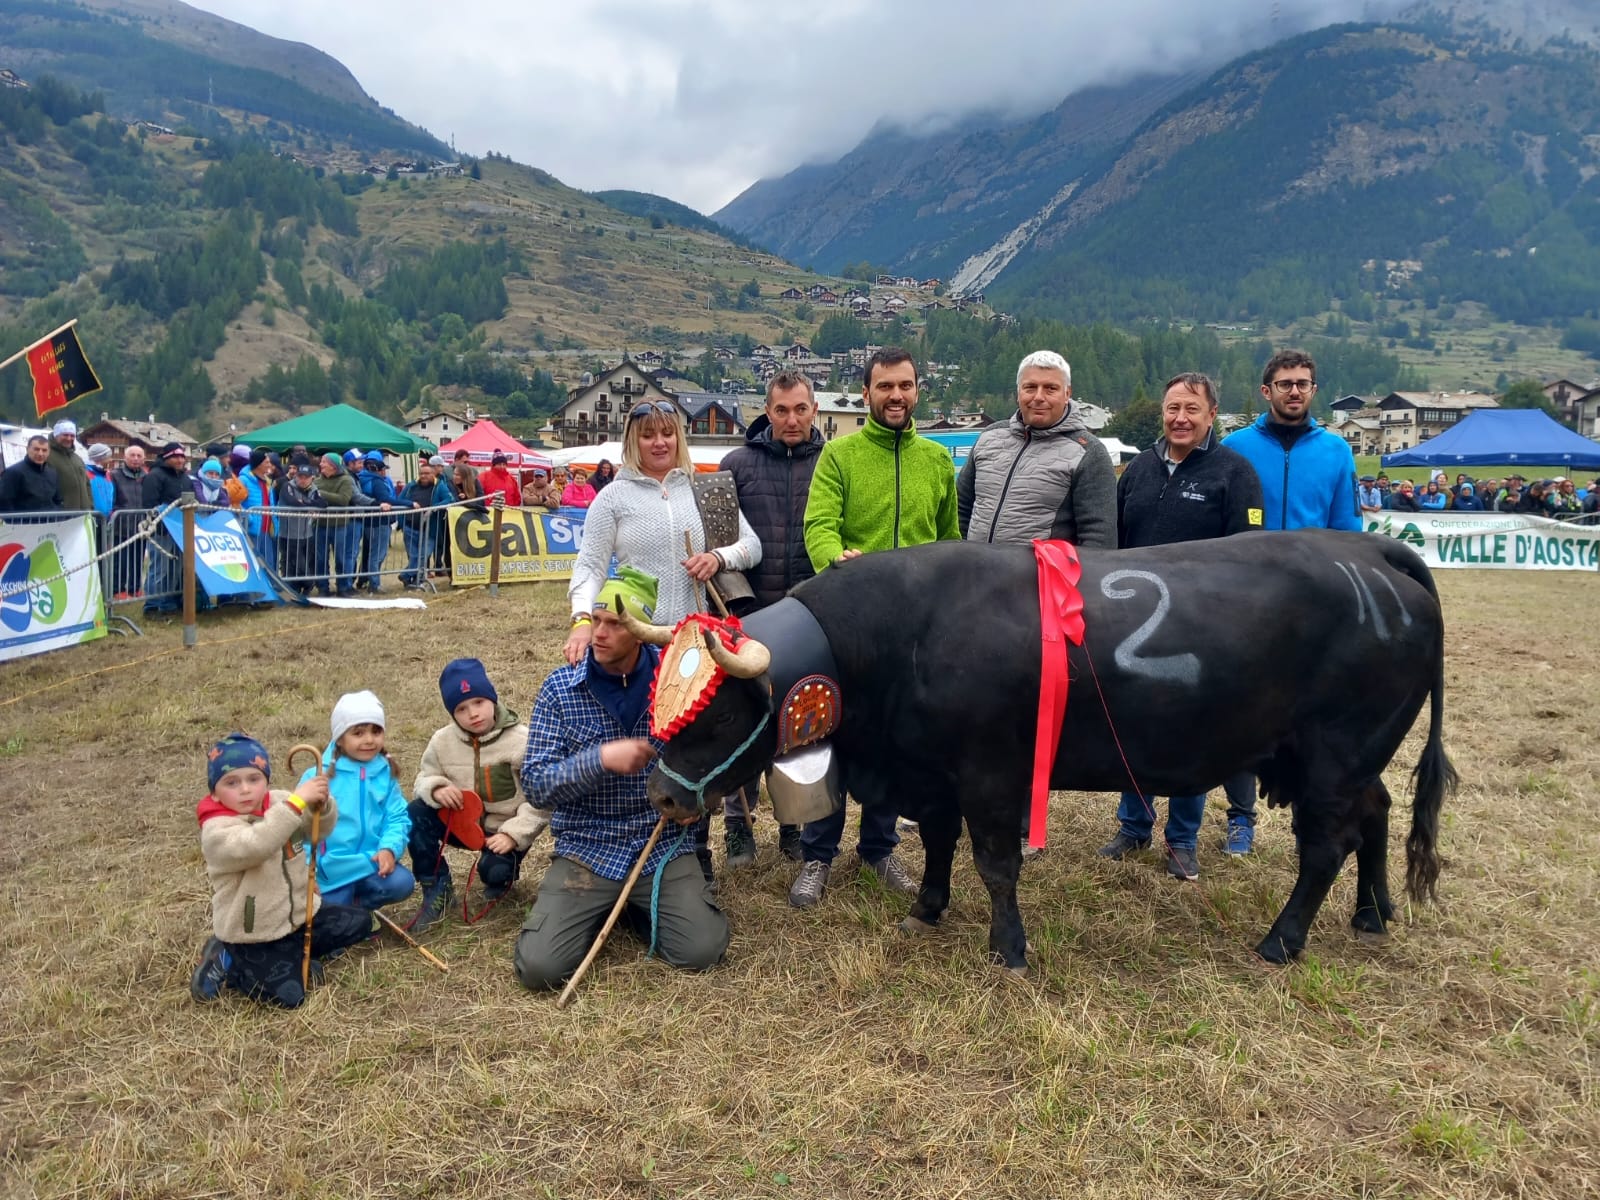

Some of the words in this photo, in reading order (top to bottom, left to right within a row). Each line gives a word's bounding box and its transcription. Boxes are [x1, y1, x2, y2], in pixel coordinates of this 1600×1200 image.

[195, 535, 242, 554] DIGEL
[455, 510, 540, 558] Gal
[1437, 534, 1507, 563] VALLE
[1515, 534, 1599, 567] D'AOSTA
[456, 561, 487, 577] BIKE
[498, 560, 542, 575] XPRESS
[1101, 569, 1200, 674] 2
